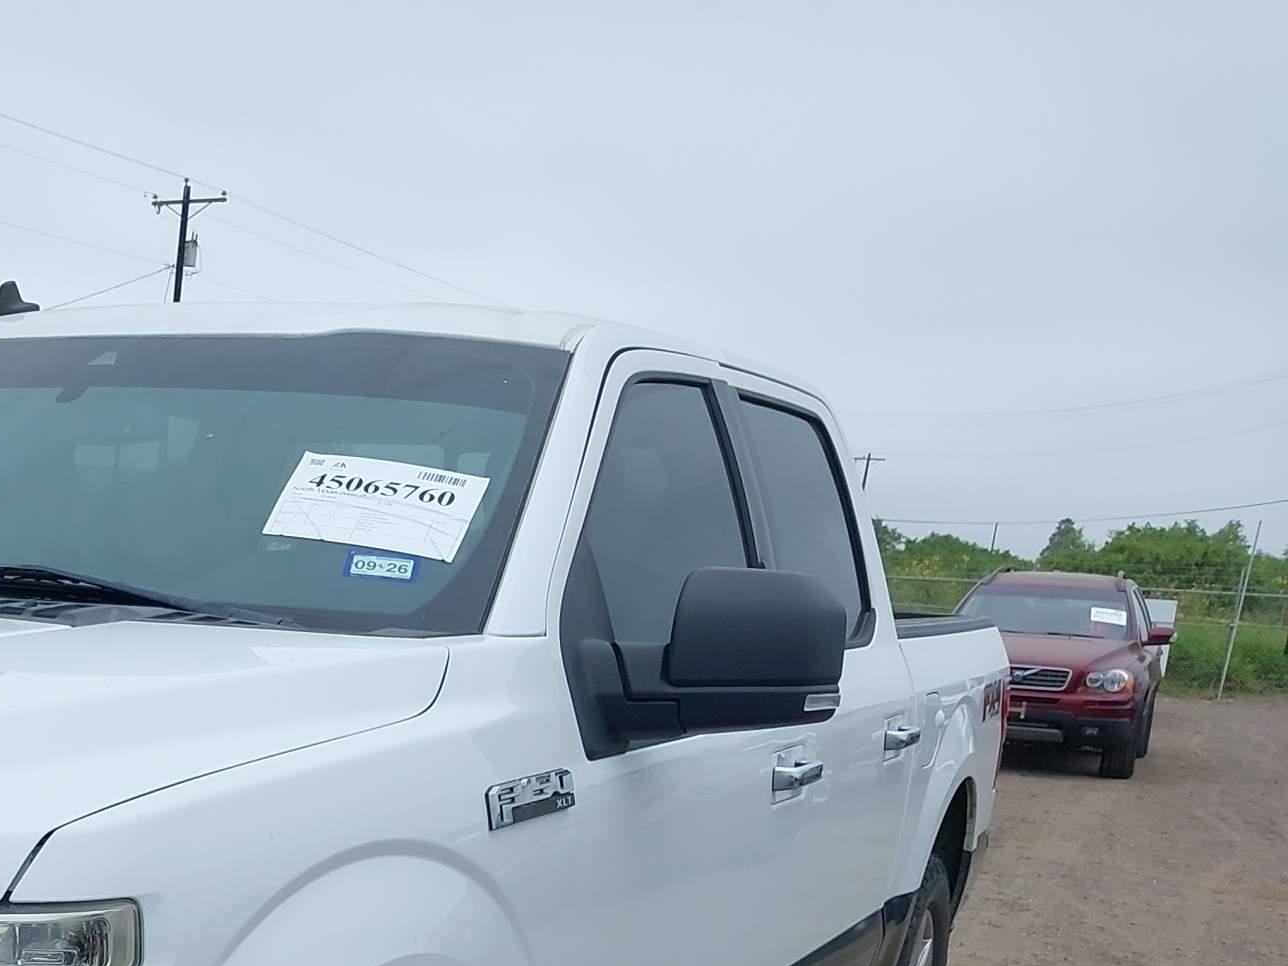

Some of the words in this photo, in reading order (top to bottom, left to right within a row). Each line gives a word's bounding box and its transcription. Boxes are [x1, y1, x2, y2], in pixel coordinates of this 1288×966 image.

[308, 472, 456, 507] 45065760
[354, 559, 377, 571] 09
[385, 562, 409, 574] 26
[556, 796, 573, 809] XLT
